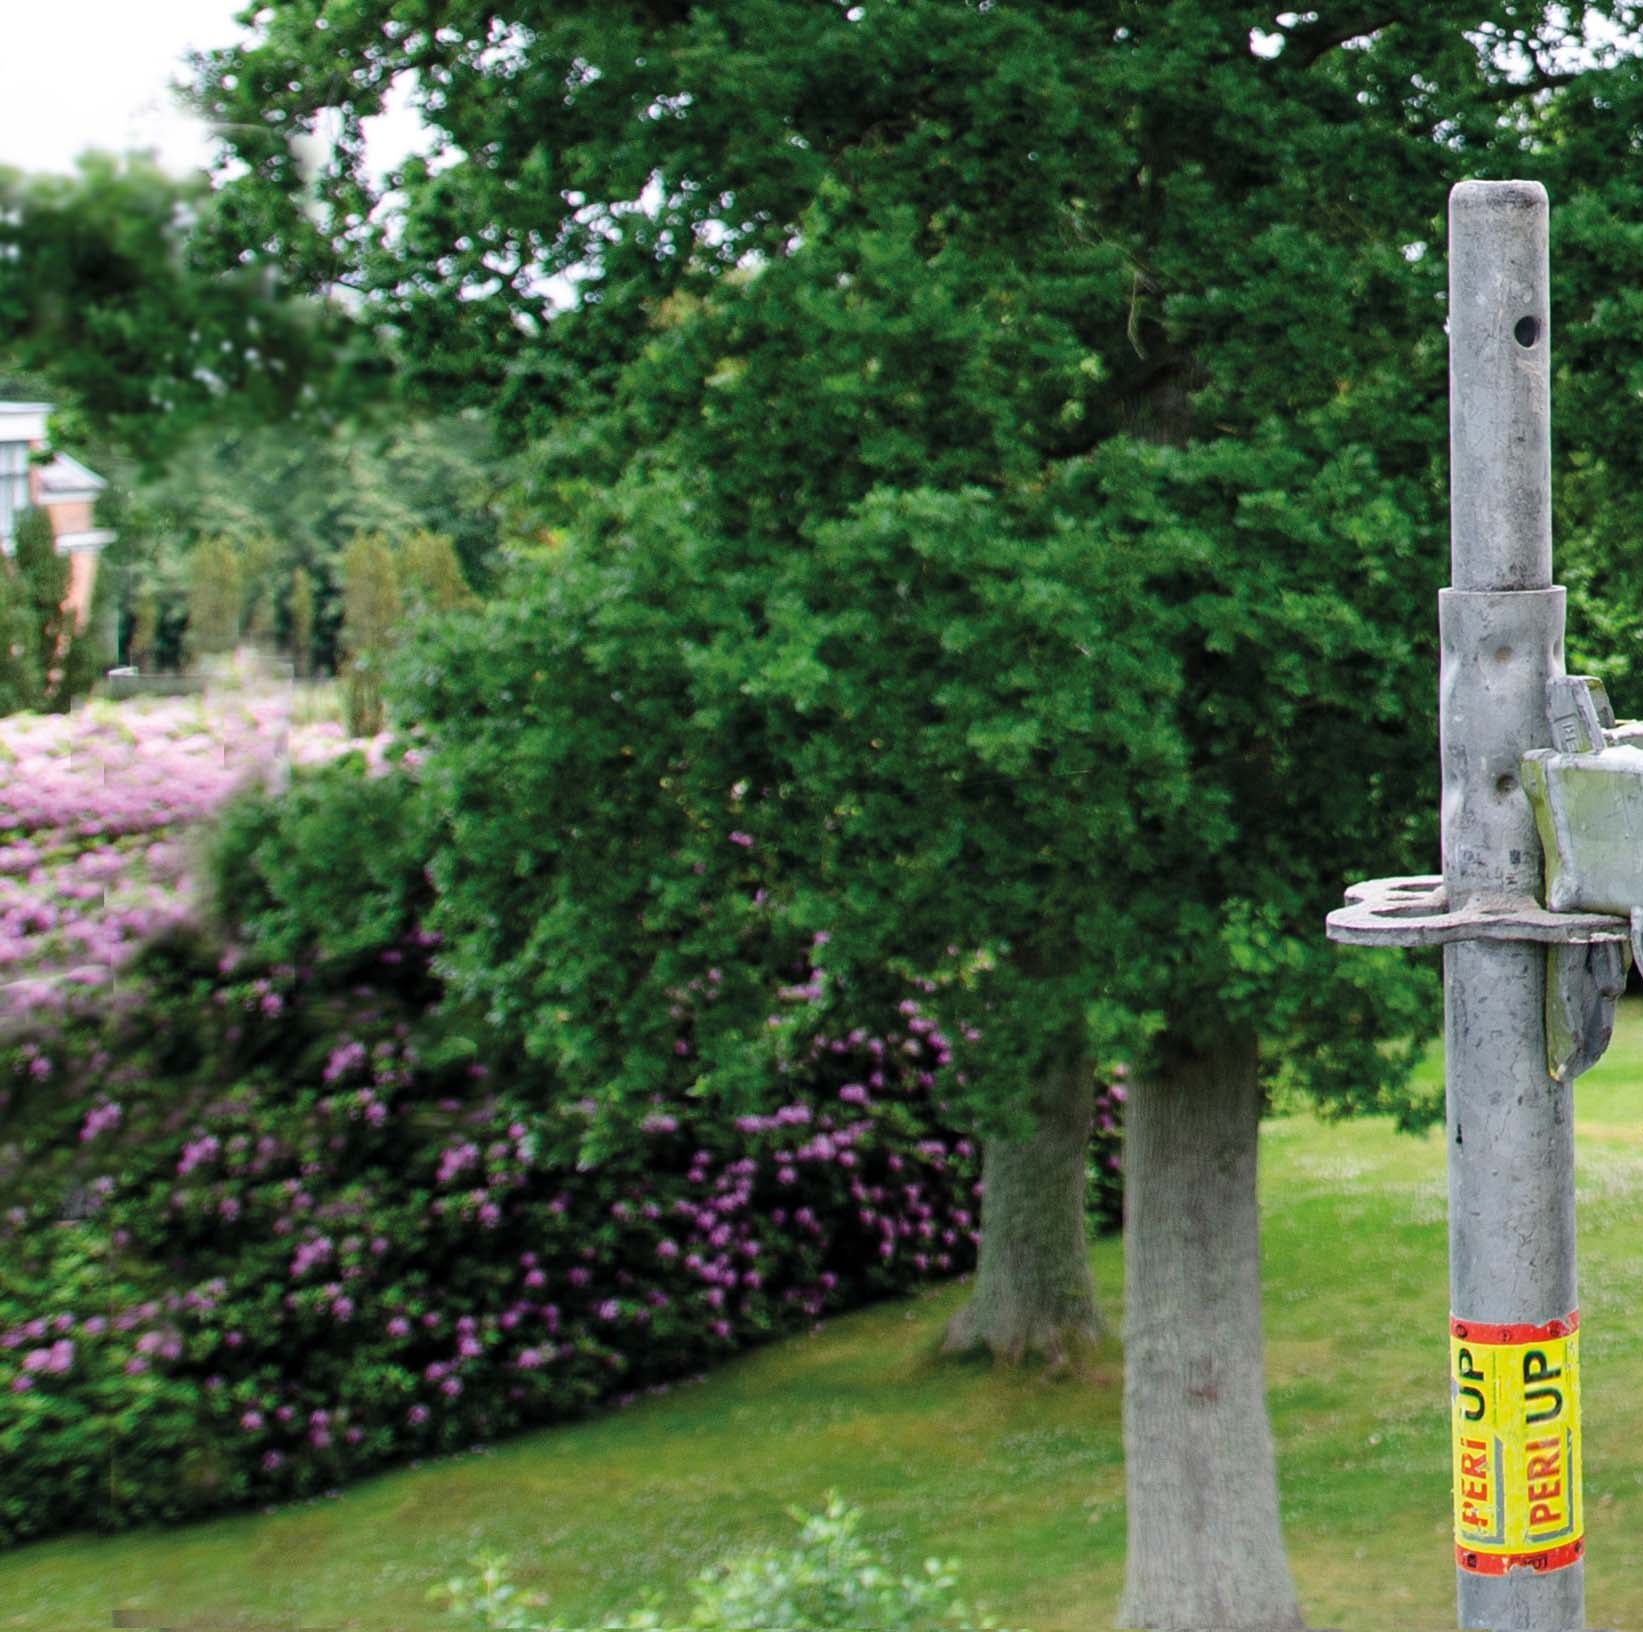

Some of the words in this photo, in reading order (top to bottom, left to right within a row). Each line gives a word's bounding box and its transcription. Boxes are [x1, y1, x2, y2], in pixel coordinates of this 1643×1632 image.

[1457, 1347, 1486, 1422] UP
[1522, 1350, 1563, 1425] UP
[1460, 1437, 1488, 1529] PERI
[1525, 1437, 1562, 1527] PERI
